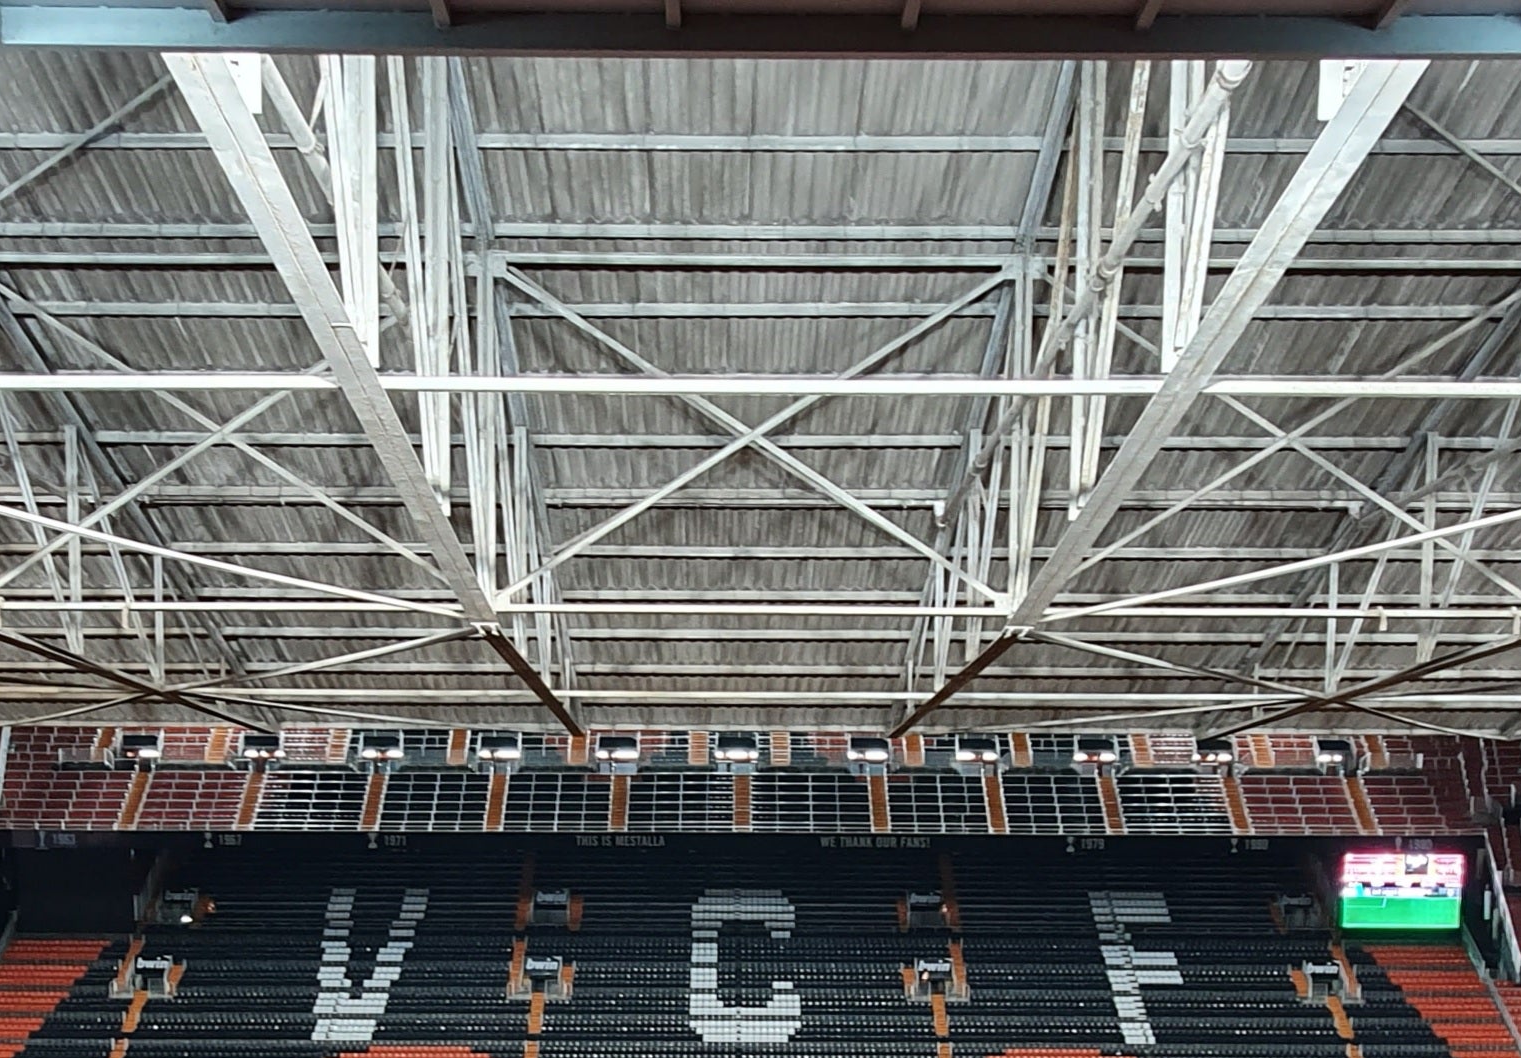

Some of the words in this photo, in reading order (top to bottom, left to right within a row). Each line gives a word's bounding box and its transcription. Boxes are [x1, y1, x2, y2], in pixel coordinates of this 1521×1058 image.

[576, 835, 599, 847] THIS
[602, 835, 612, 847] IS
[615, 835, 666, 847] MESTALLA
[820, 837, 836, 848] WE
[839, 836, 873, 848] THANK
[899, 837, 931, 849] FANS!
[136, 956, 170, 970] bwin
[310, 887, 430, 1042] V
[689, 888, 801, 1043] C
[1087, 890, 1185, 1045] F
[525, 957, 559, 971] bwin
[917, 959, 951, 972] bwin
